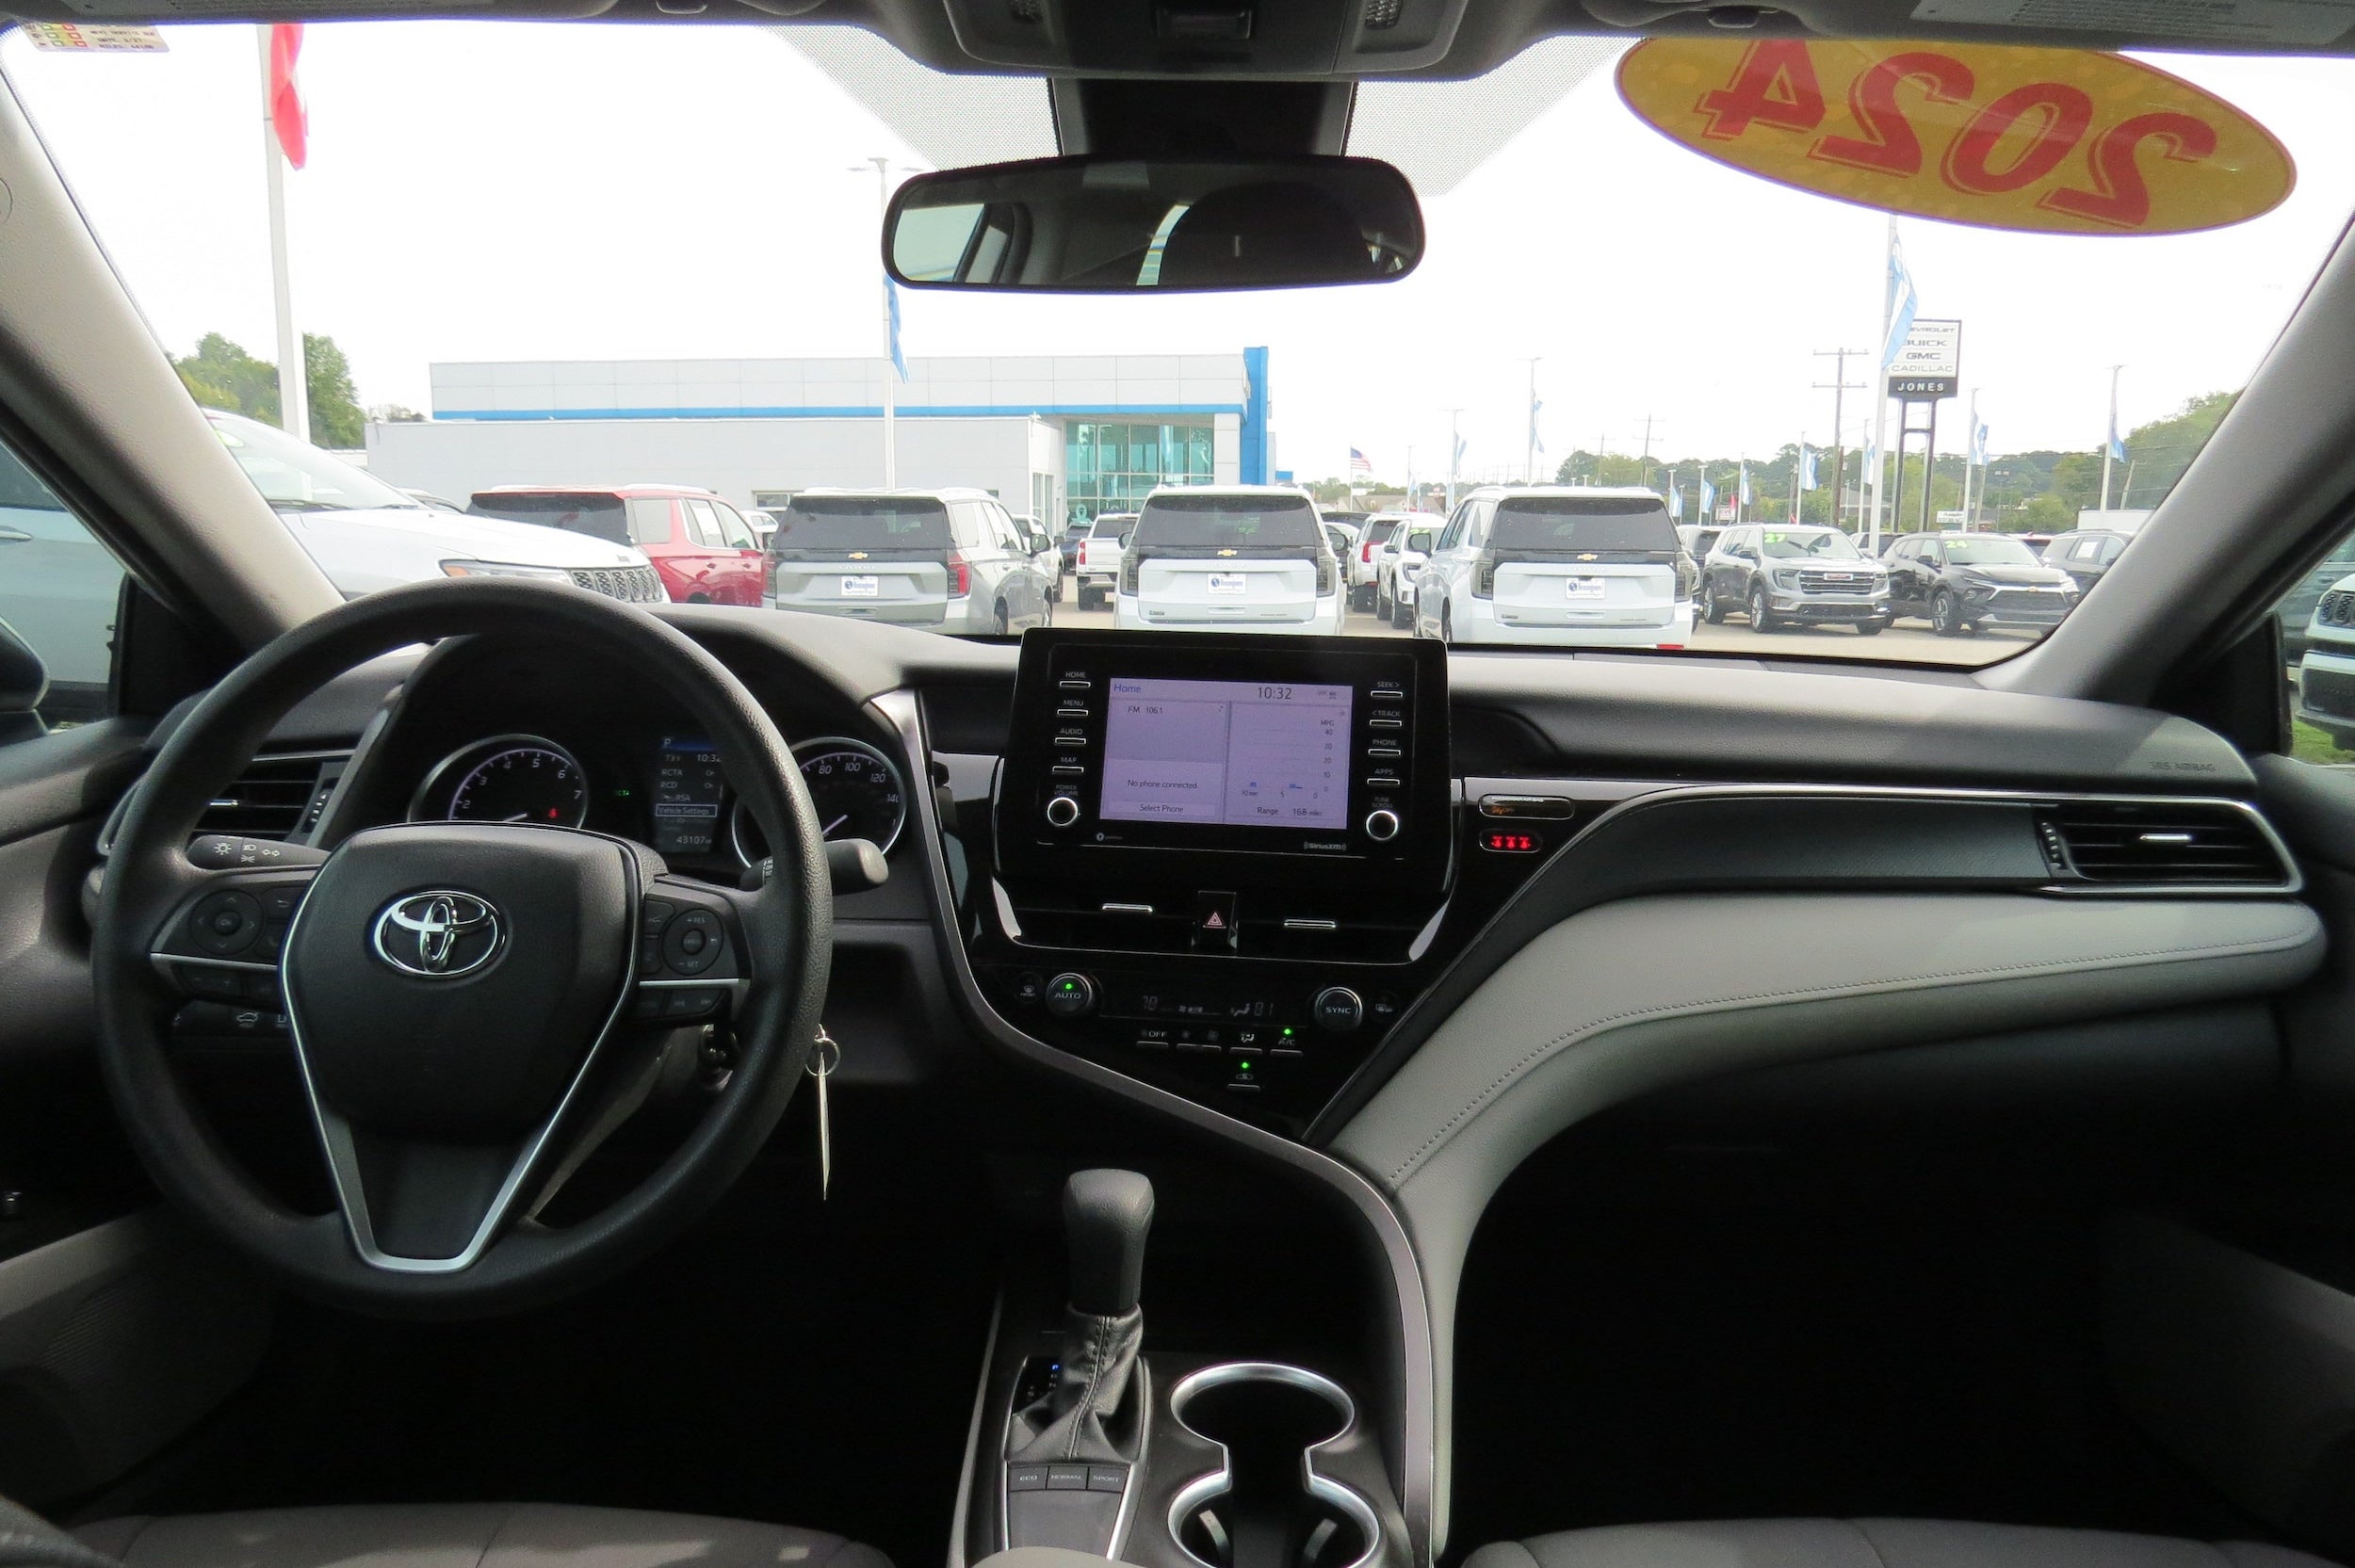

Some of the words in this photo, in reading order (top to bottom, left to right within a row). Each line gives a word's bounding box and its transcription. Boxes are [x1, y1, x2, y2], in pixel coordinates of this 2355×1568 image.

[1897, 382, 1945, 392] JONES
[1764, 533, 1787, 543] 27
[1113, 684, 1142, 693] Home
[1258, 687, 1291, 700] 10:32
[503, 761, 512, 769] 4
[532, 759, 540, 768] 5
[845, 763, 861, 772] 100
[819, 765, 832, 774] 80
[558, 770, 565, 779] 6
[870, 773, 886, 783] 120
[479, 777, 487, 785] 3
[1128, 779, 1138, 787] No
[1139, 780, 1161, 788] phone
[1162, 781, 1197, 789] connected
[575, 790, 581, 799] 7
[462, 800, 470, 809] 2
[1140, 803, 1161, 812] Select
[1258, 807, 1278, 816] Range
[1277, 1038, 1296, 1046] A/C
